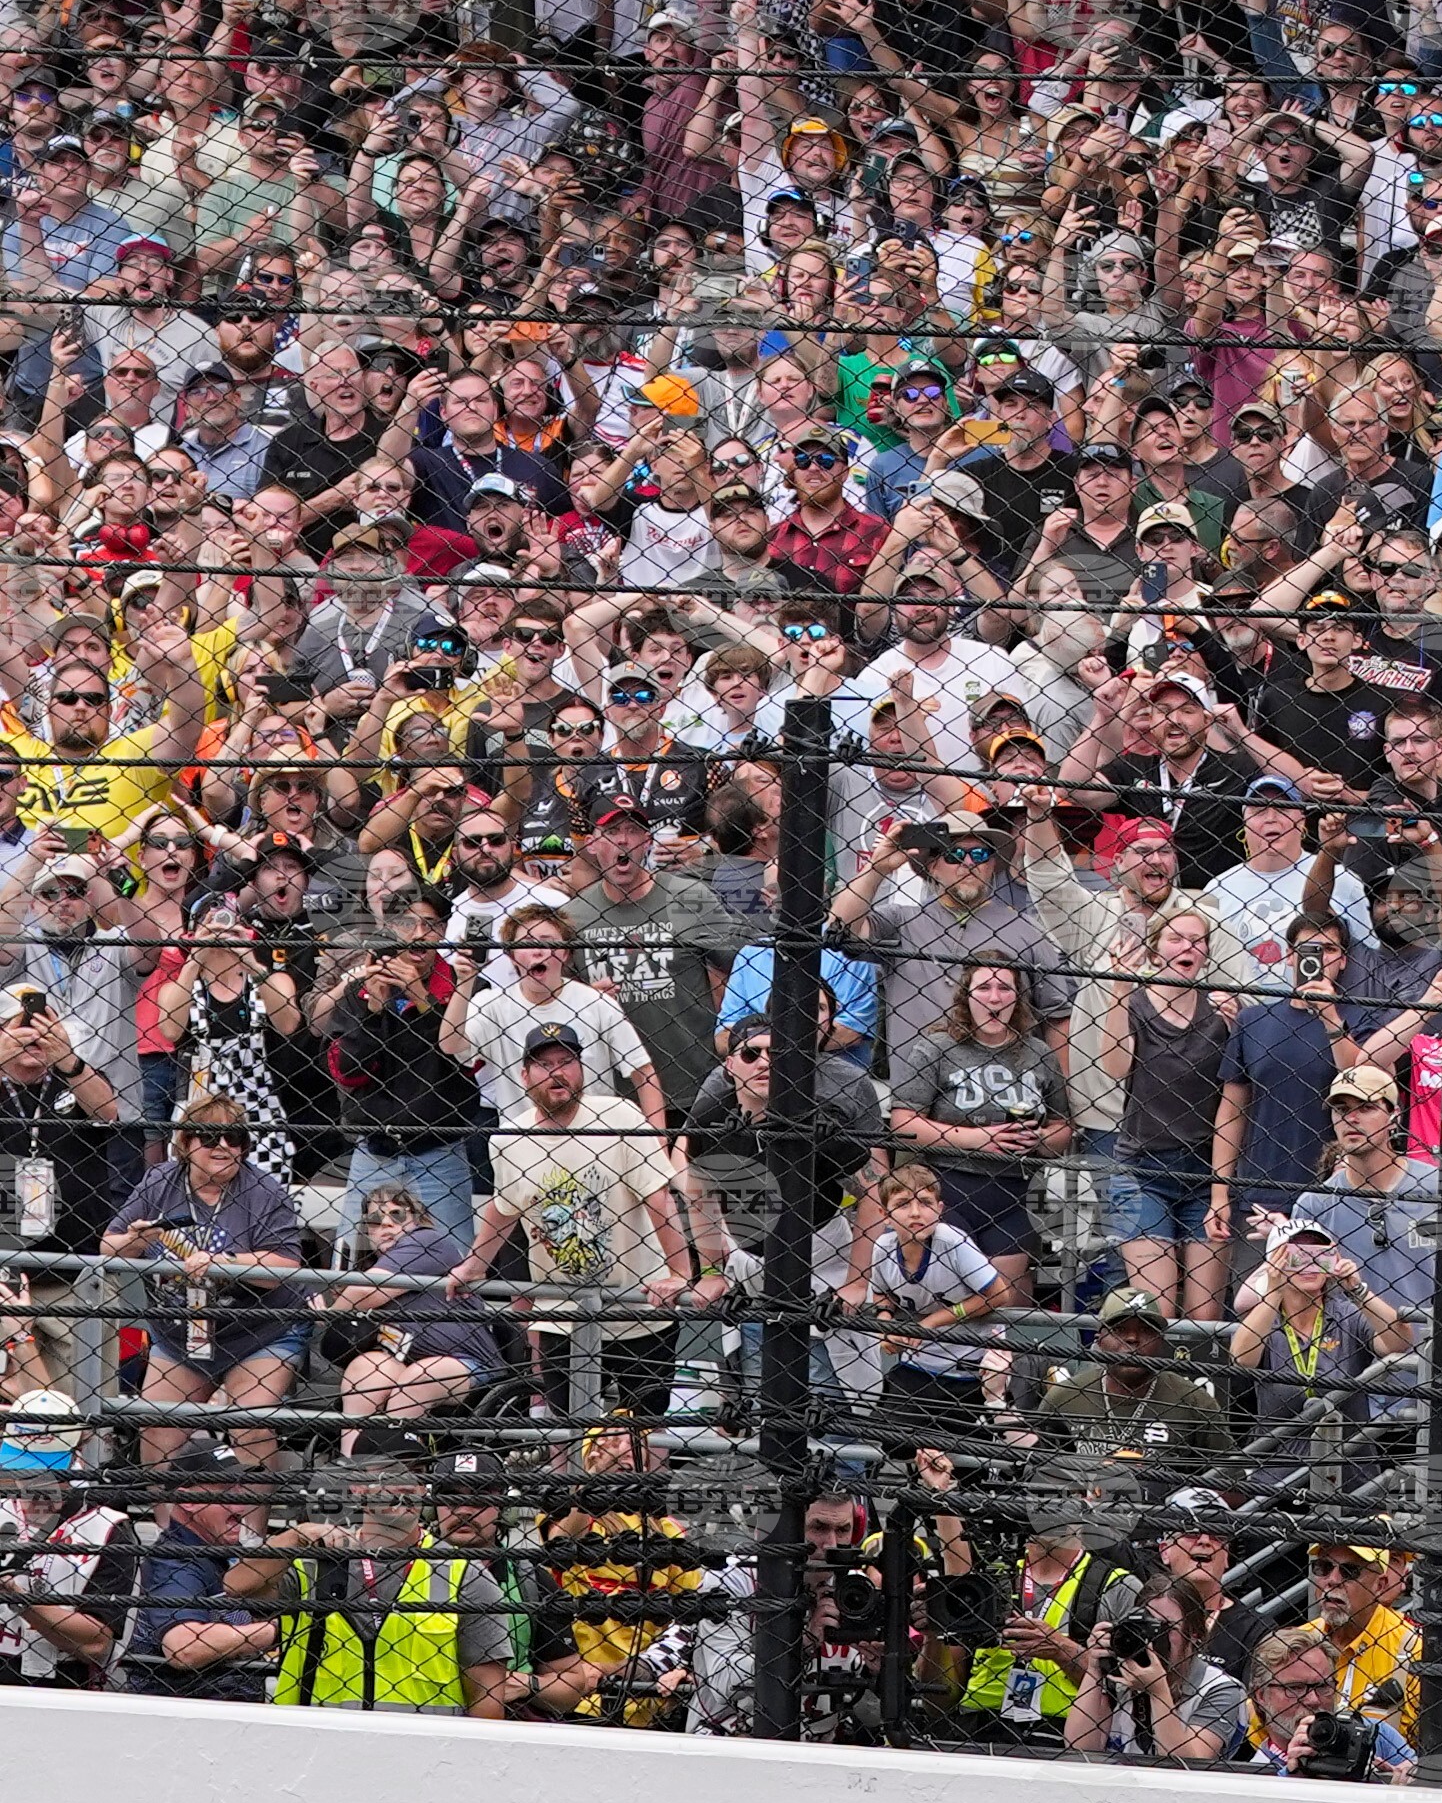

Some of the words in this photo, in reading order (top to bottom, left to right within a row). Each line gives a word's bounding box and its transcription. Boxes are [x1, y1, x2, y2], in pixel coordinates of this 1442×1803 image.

[583, 926, 618, 940] THAT'S
[620, 924, 649, 938] WHAT
[658, 922, 673, 934] DO
[585, 954, 675, 982] MEAT
[633, 987, 675, 1002] THINGS
[950, 1064, 1047, 1115] USA
